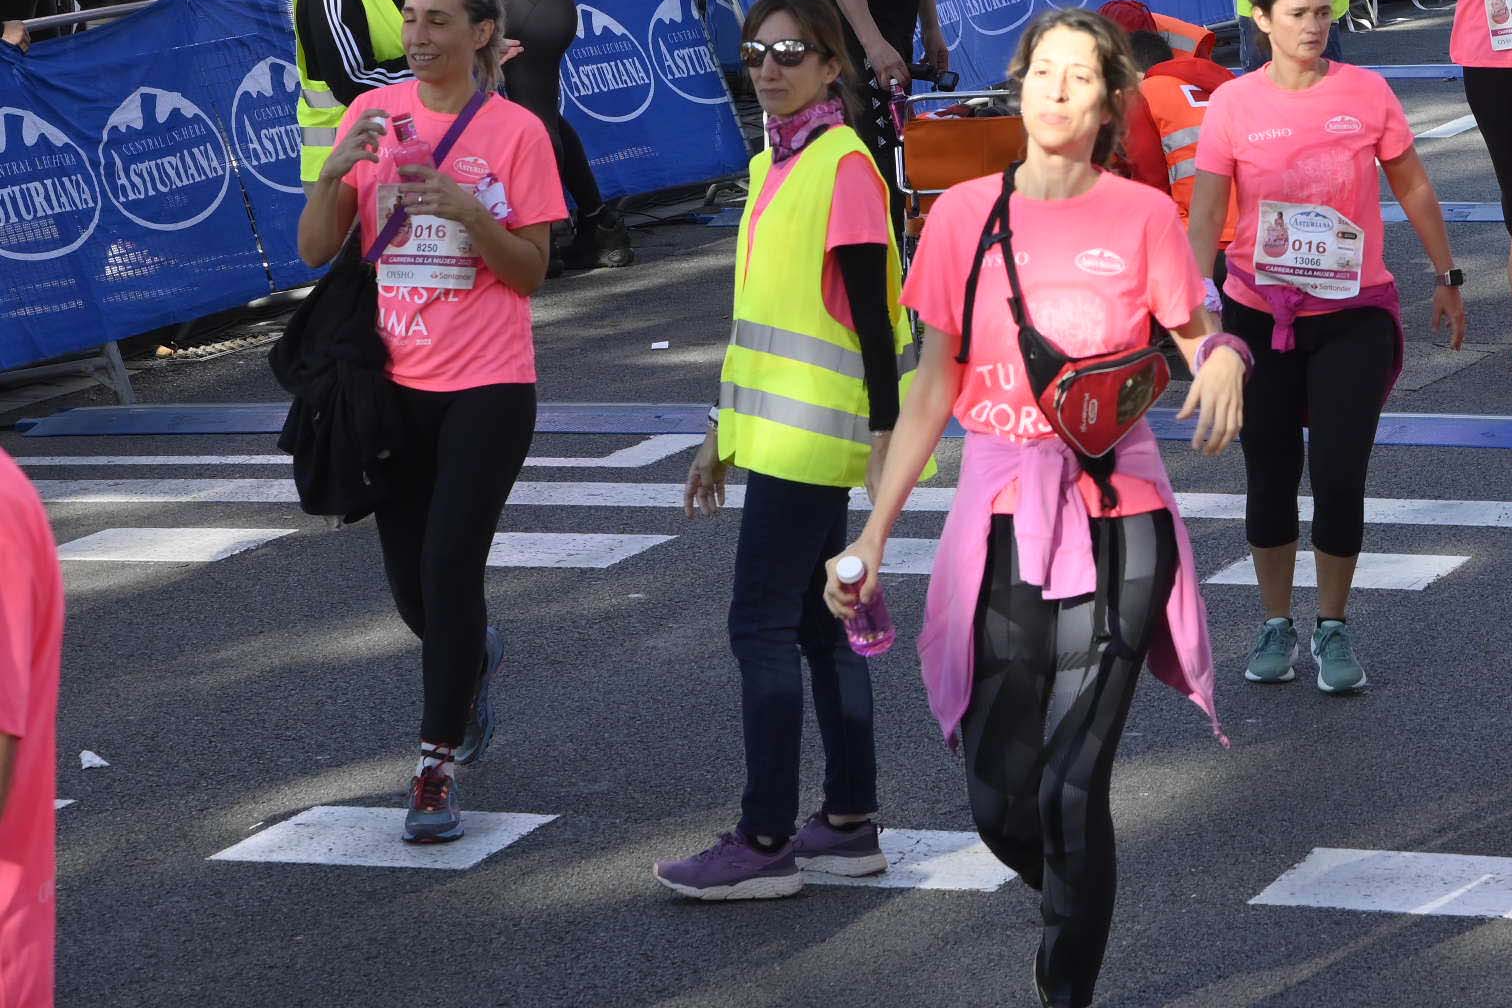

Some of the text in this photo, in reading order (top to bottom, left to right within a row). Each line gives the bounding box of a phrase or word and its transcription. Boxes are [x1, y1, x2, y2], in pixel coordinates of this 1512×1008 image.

[658, 36, 718, 80] ASTUR
[564, 51, 650, 98] ASTURIANA
[1248, 127, 1293, 143] OYSHO
[122, 136, 165, 157] CENTRAL
[111, 142, 224, 203] ASTURIANA
[413, 224, 446, 240] 016
[416, 242, 438, 253] 8250
[1291, 239, 1327, 255] 016
[1294, 256, 1321, 267] 13066
[975, 362, 1016, 391] TU
